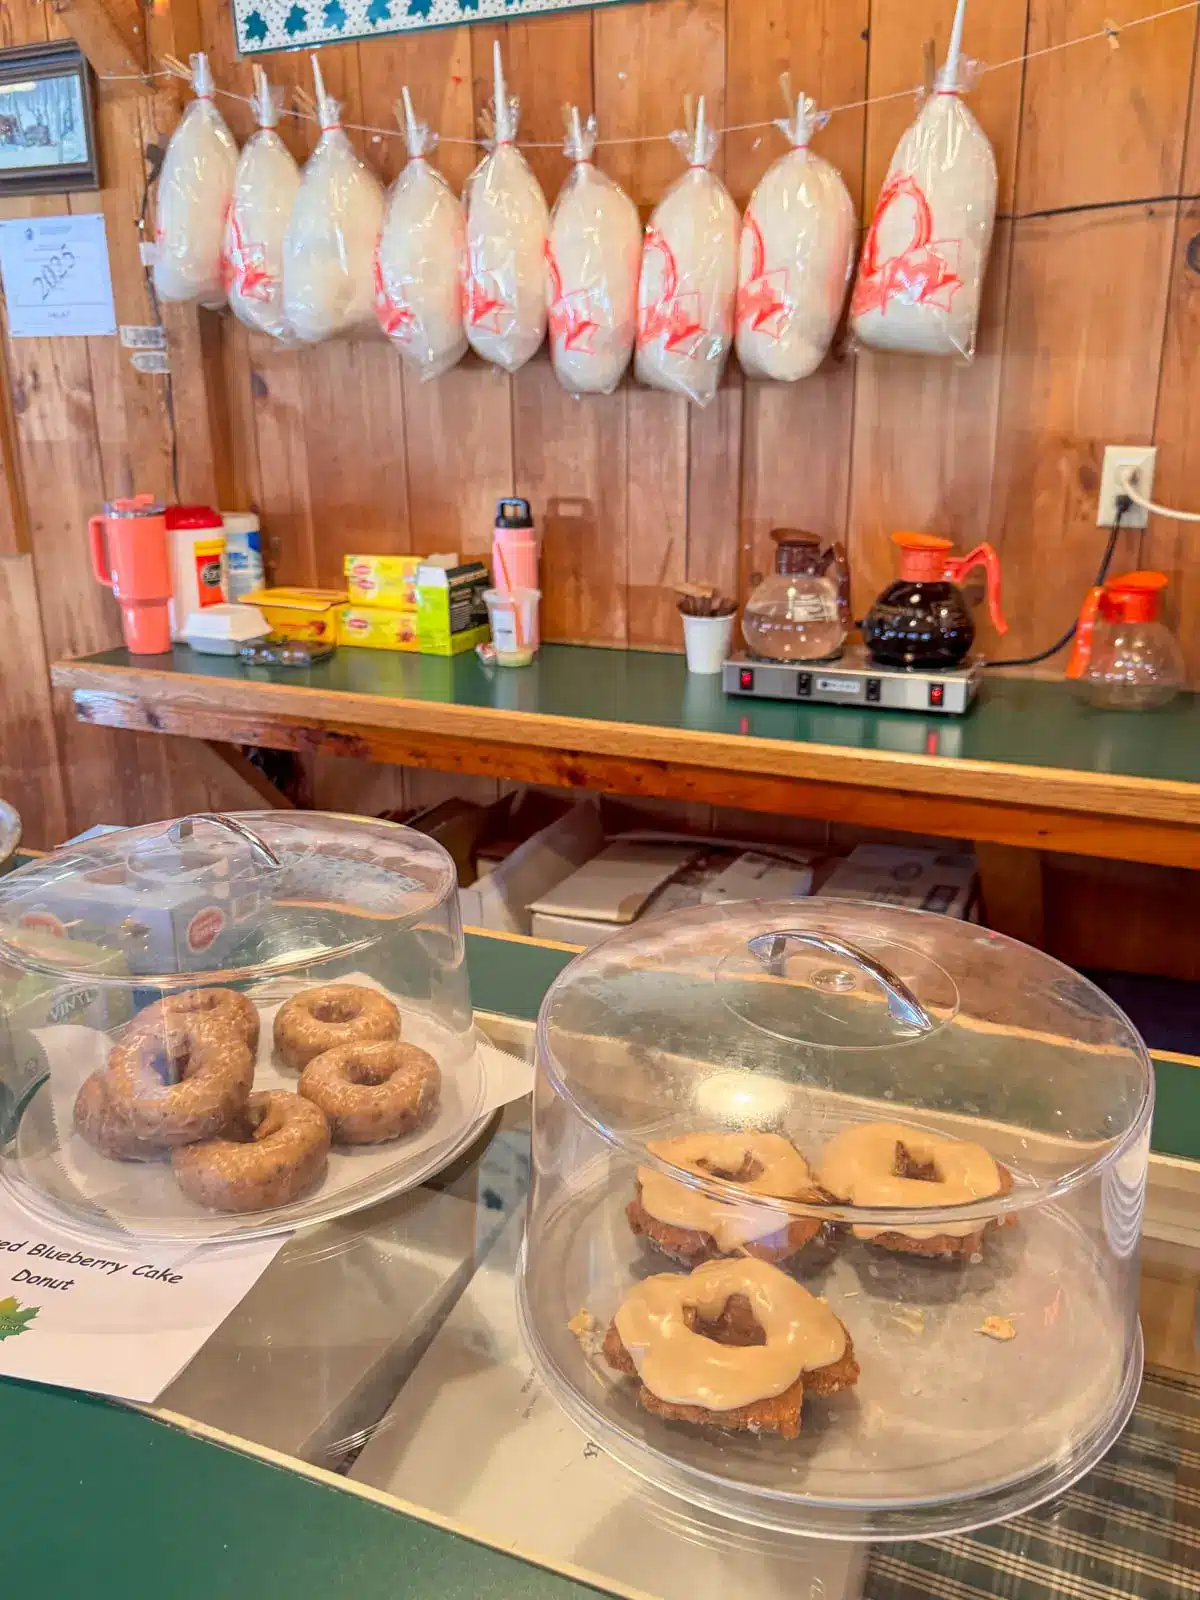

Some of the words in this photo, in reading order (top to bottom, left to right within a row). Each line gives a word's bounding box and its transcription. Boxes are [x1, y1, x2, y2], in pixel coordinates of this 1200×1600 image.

[50, 990, 93, 1022] VINYL
[0, 1239, 29, 1252] ed
[27, 1243, 128, 1275] Blueberry
[132, 1264, 183, 1284] Cake
[11, 1268, 75, 1291] Donut
